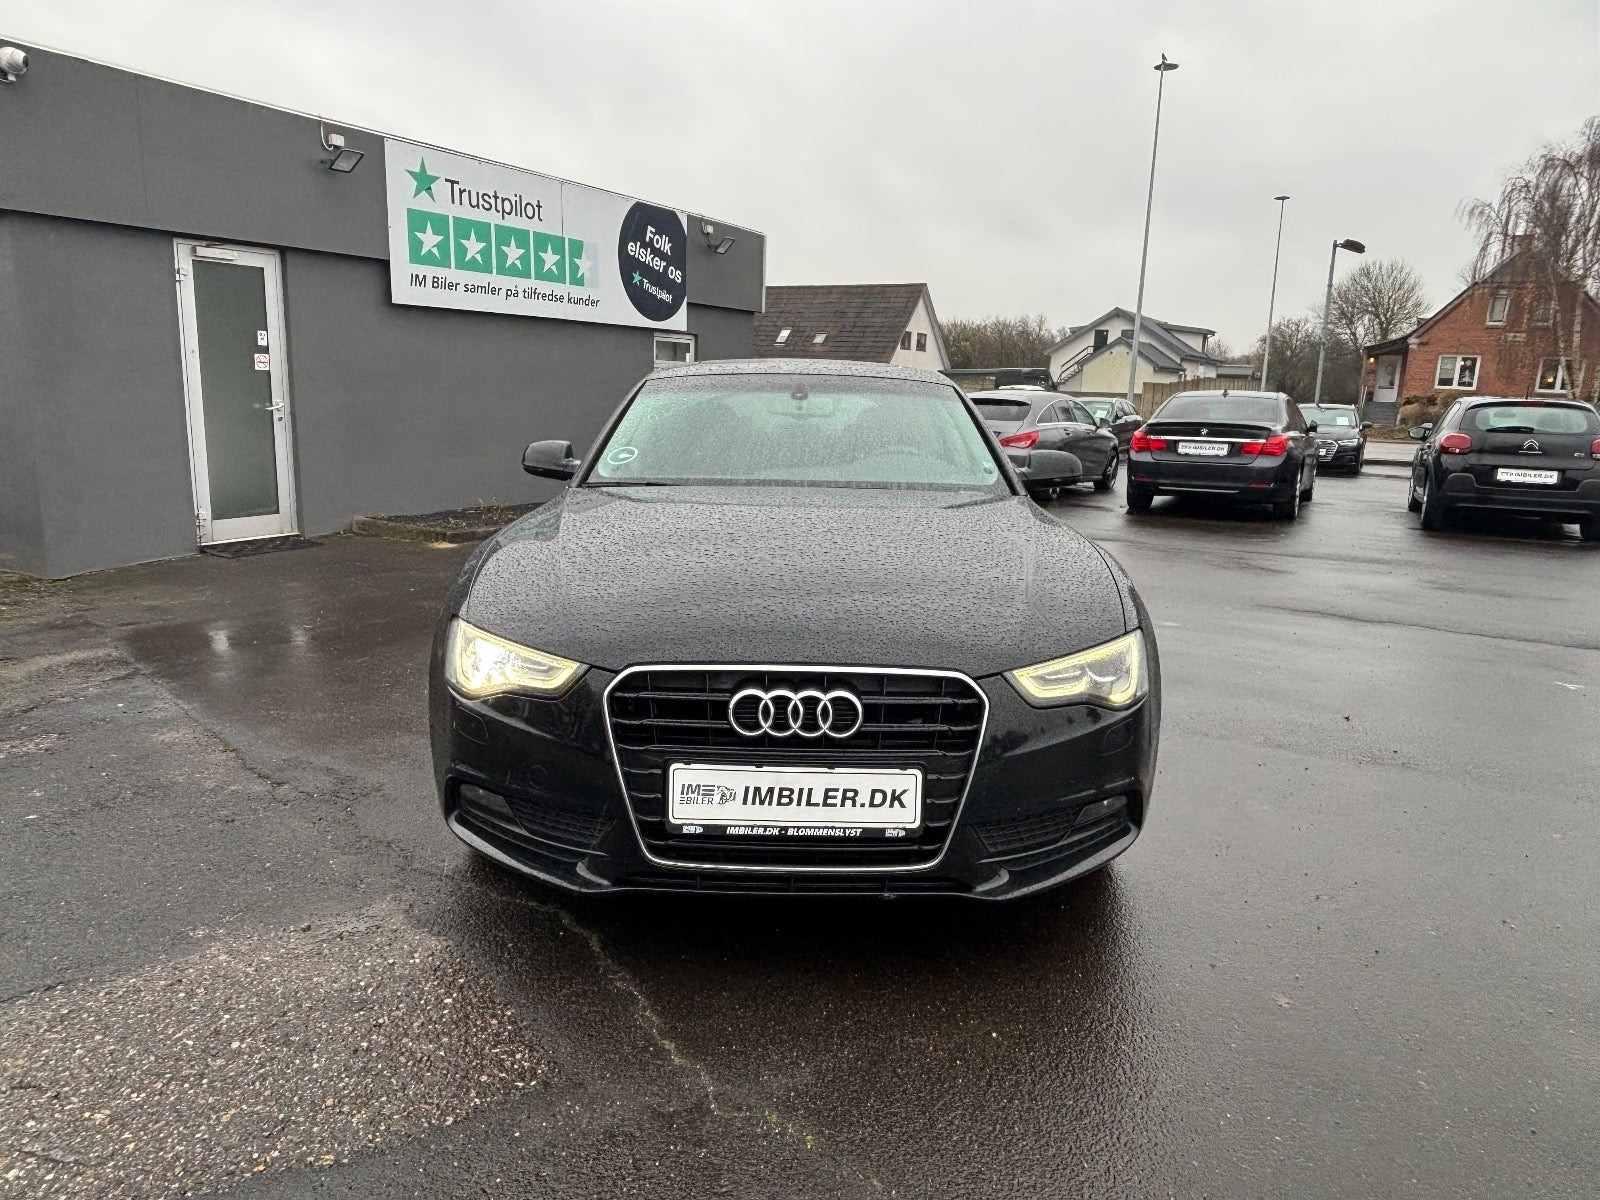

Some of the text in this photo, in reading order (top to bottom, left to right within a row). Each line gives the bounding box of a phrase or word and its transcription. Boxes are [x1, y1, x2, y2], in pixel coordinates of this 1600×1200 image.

[444, 177, 543, 222] Trustpilot
[645, 225, 672, 256] Folk
[627, 241, 682, 284] elsker os
[409, 273, 600, 308] IM Biler samler på tilfredse kunder
[642, 278, 673, 304] Trustpilot
[742, 785, 910, 809] IMBILER.DK
[726, 826, 779, 836] IMBILER.DK
[787, 827, 862, 837] BLOMMENSLYST
